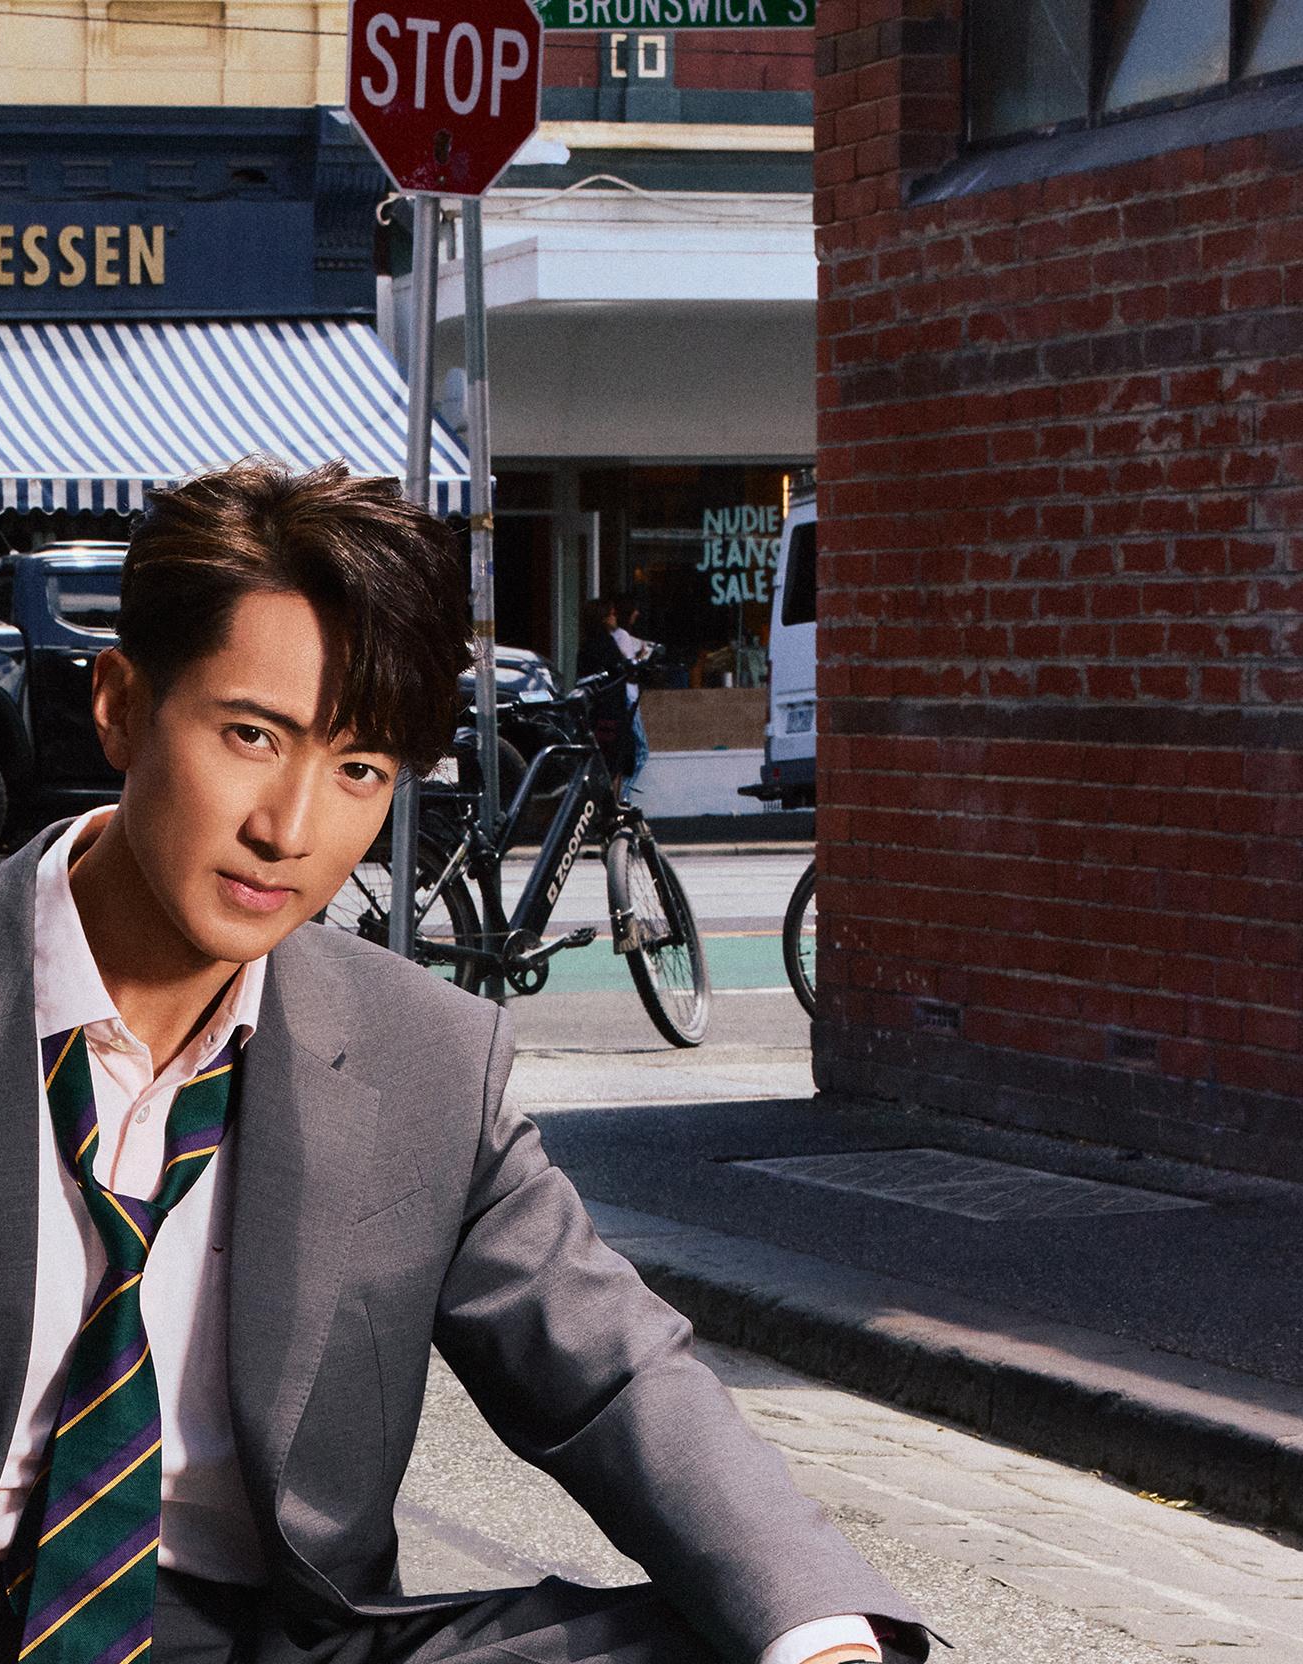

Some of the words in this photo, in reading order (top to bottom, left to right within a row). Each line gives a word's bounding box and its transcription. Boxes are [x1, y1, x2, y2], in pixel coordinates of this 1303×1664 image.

[568, 0, 766, 24] BRUNSWICK
[361, 13, 529, 117] STOP
[703, 504, 779, 538] NUDIE
[697, 536, 782, 571] JEANS
[711, 570, 768, 605] SALE
[555, 800, 595, 886] zoomo
